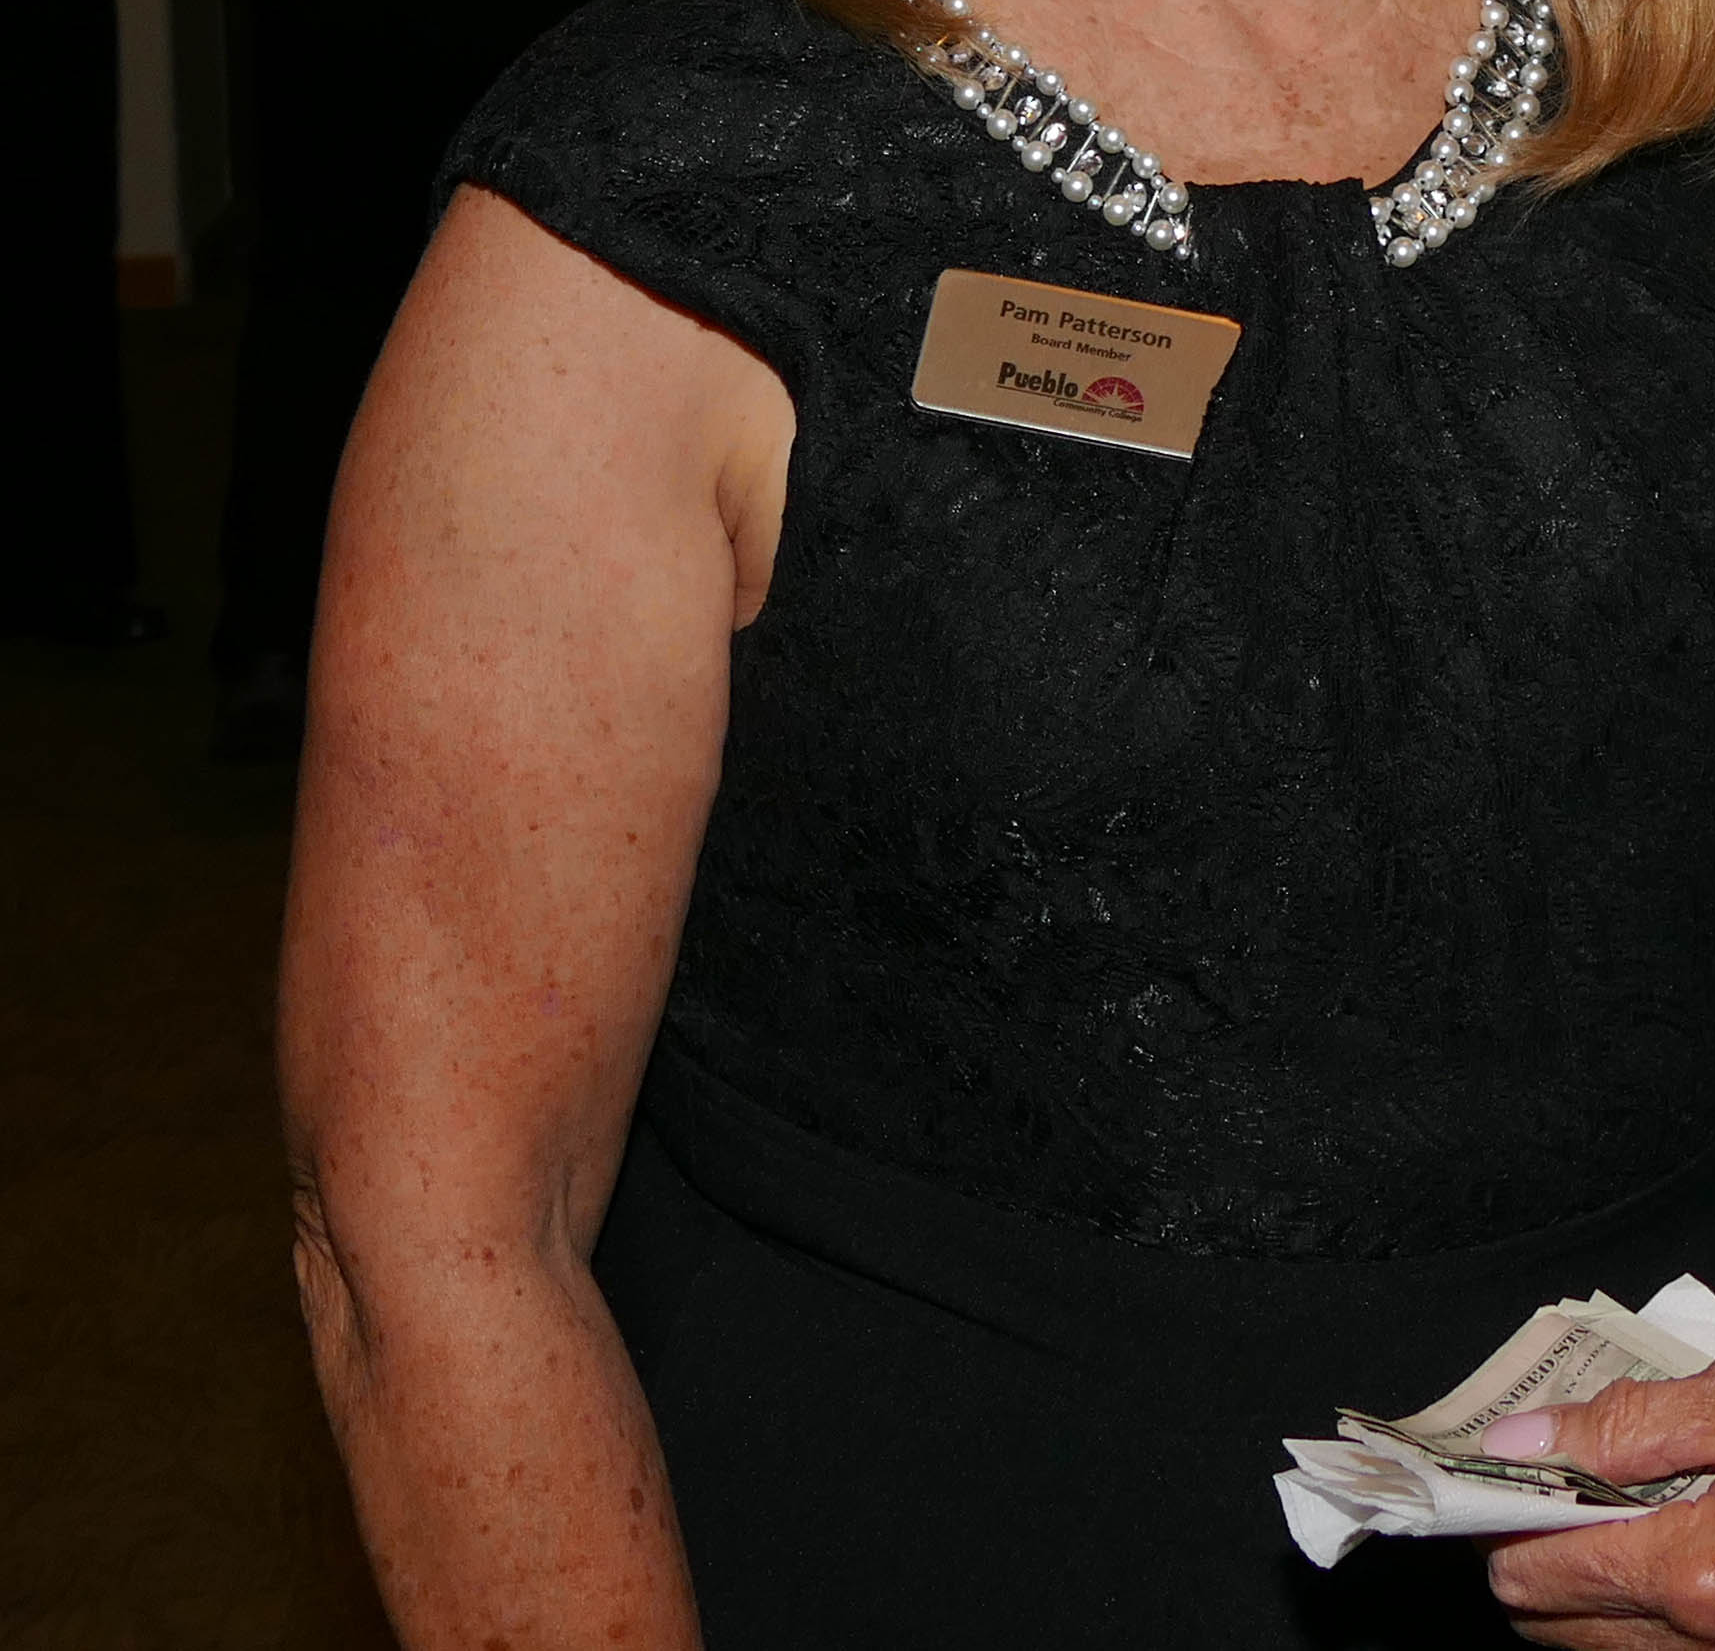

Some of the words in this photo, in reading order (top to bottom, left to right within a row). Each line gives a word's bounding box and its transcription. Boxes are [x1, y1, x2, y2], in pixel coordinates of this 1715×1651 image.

[1000, 299, 1050, 325] Pam
[1059, 311, 1173, 349] Patterson
[1031, 333, 1073, 350] Board
[1075, 343, 1132, 362] Member
[997, 361, 1080, 398] Pueblo
[1053, 398, 1106, 416] Community
[1108, 408, 1143, 423] College
[1577, 1349, 1600, 1377] GOD
[1487, 1356, 1559, 1418] UNITED
